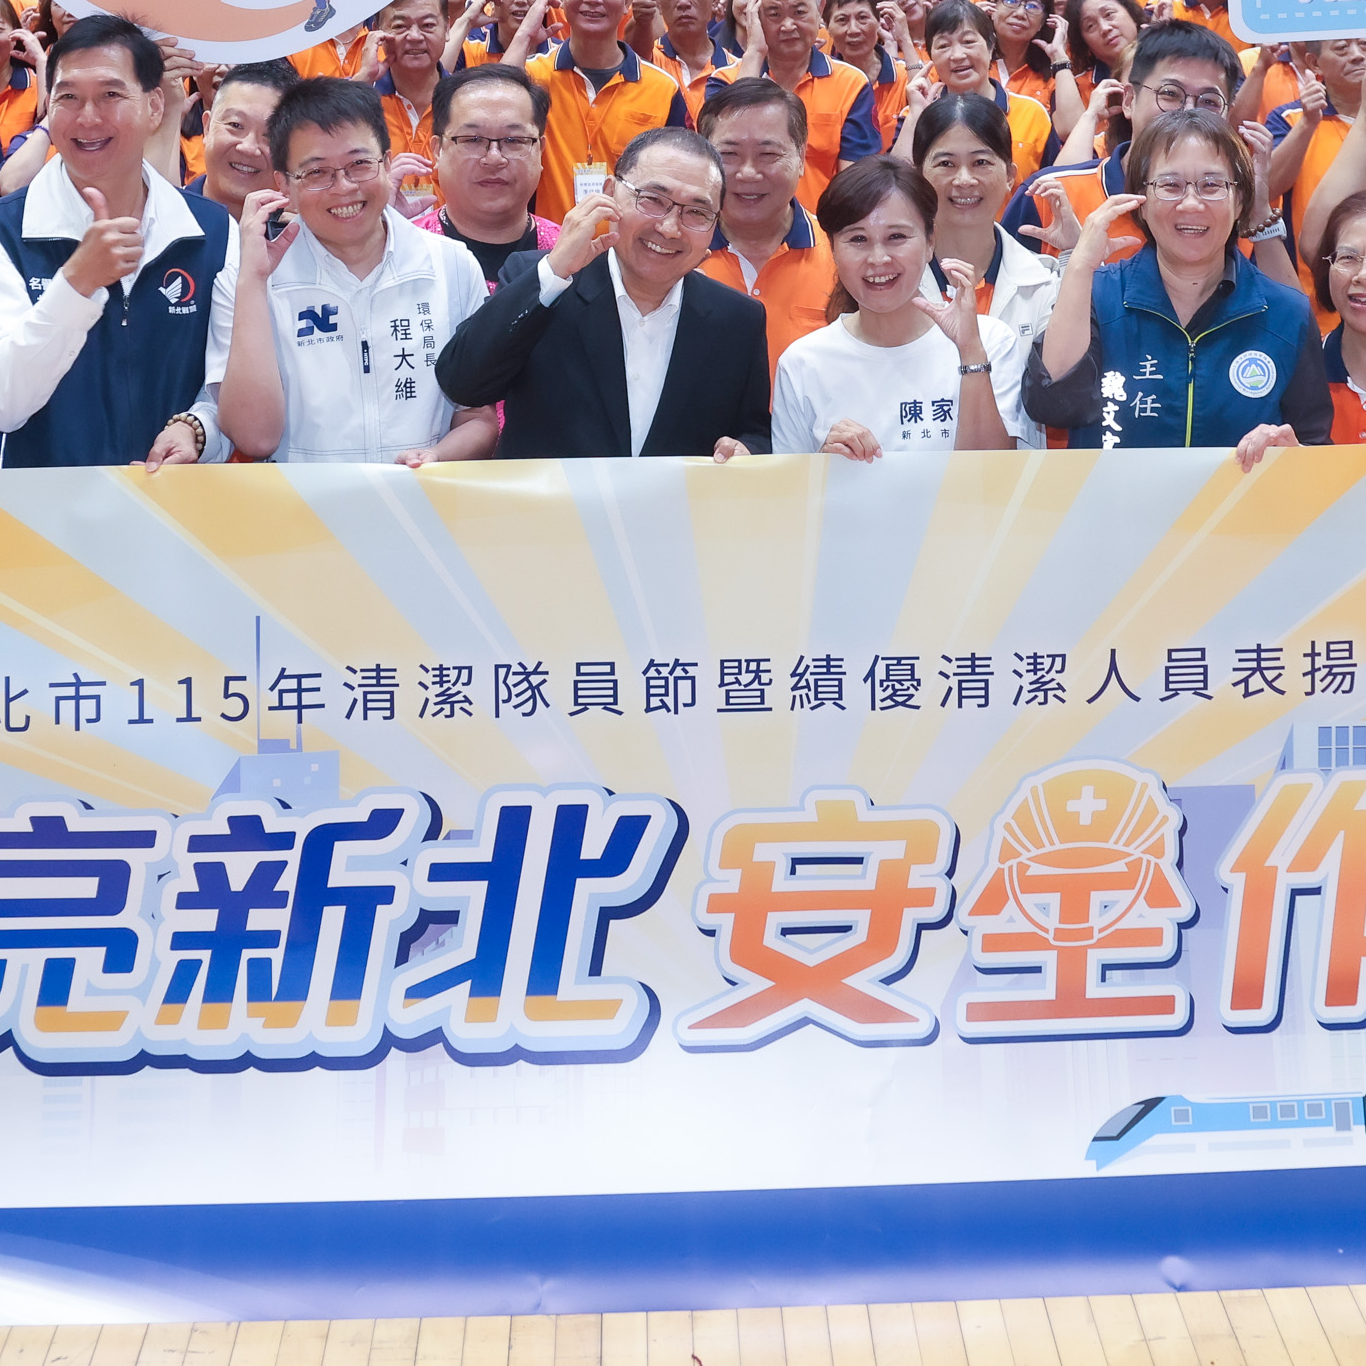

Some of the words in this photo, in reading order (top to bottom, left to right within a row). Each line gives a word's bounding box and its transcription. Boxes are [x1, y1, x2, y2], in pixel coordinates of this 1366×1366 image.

[297, 334, 344, 347] 新北市政府
[390, 318, 417, 401] 程大維
[417, 302, 437, 367] 環保局長
[1130, 354, 1164, 419] 主任
[901, 429, 950, 440] 新北市
